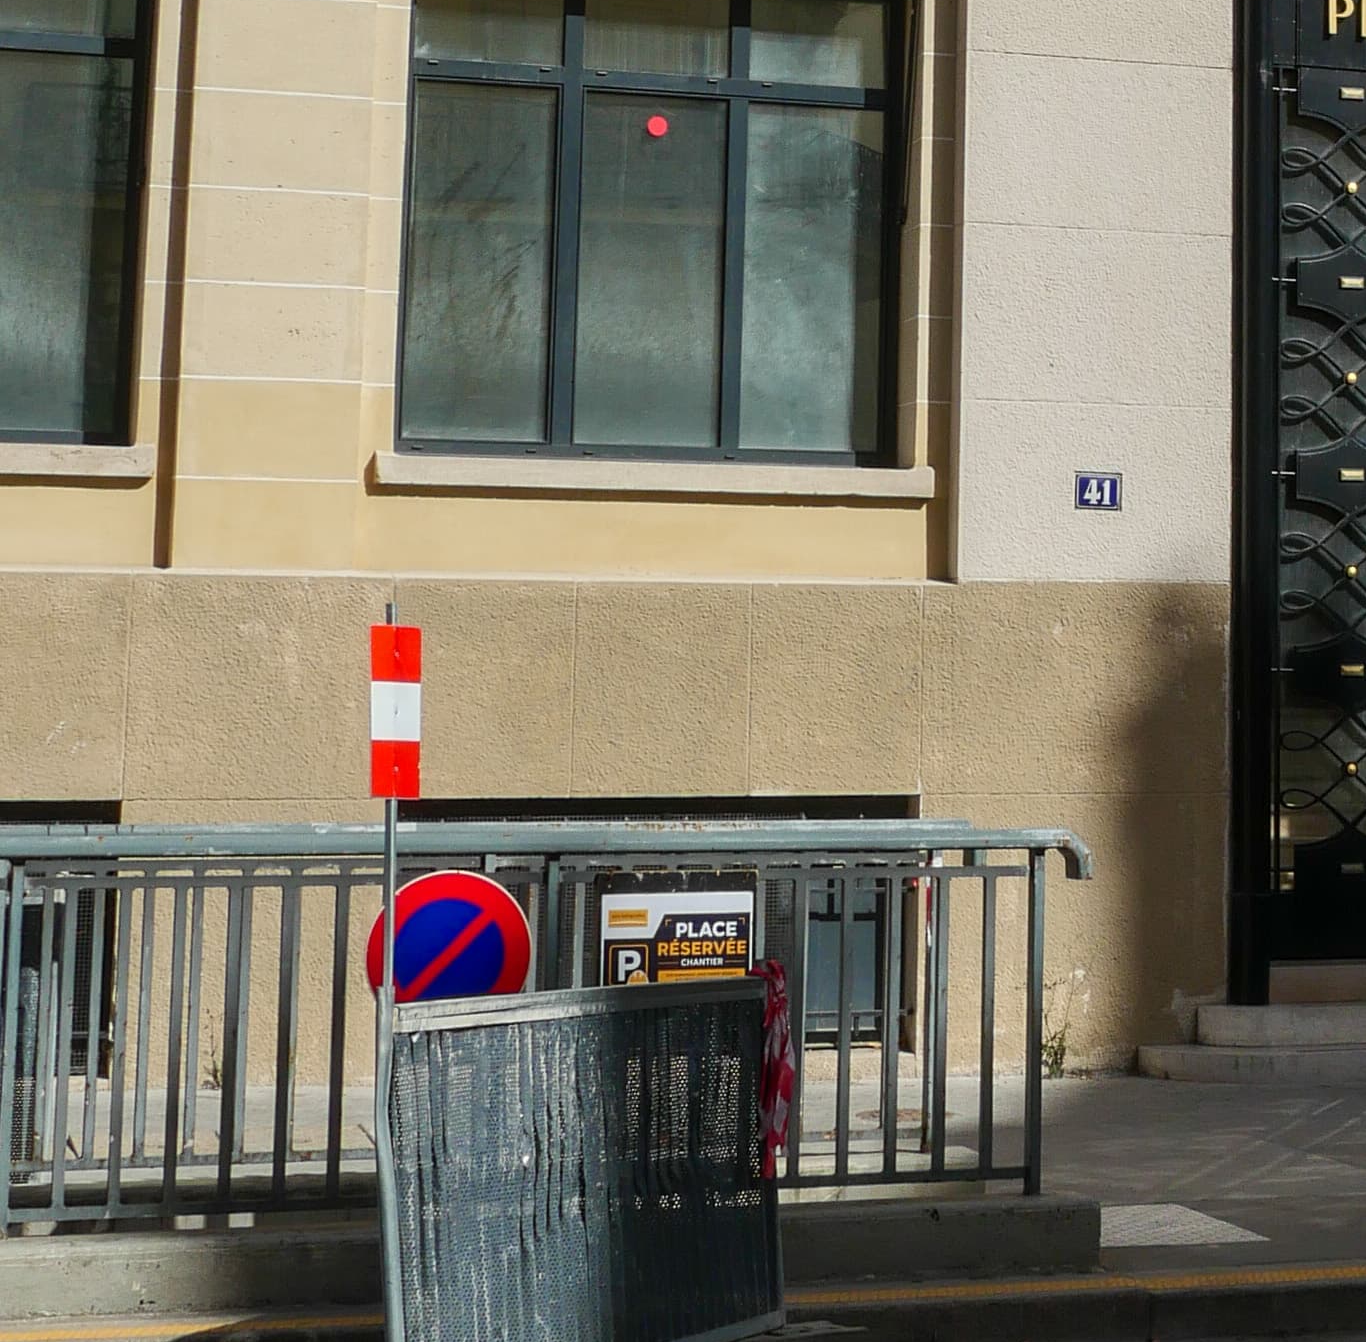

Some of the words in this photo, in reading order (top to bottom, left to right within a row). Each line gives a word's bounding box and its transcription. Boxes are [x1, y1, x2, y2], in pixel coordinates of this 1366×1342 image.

[1083, 478, 1112, 506] 41
[675, 920, 738, 939] PLACE
[657, 938, 747, 957] RÉSERVÉE
[617, 949, 642, 982] P
[680, 957, 724, 967] CHANTIER
